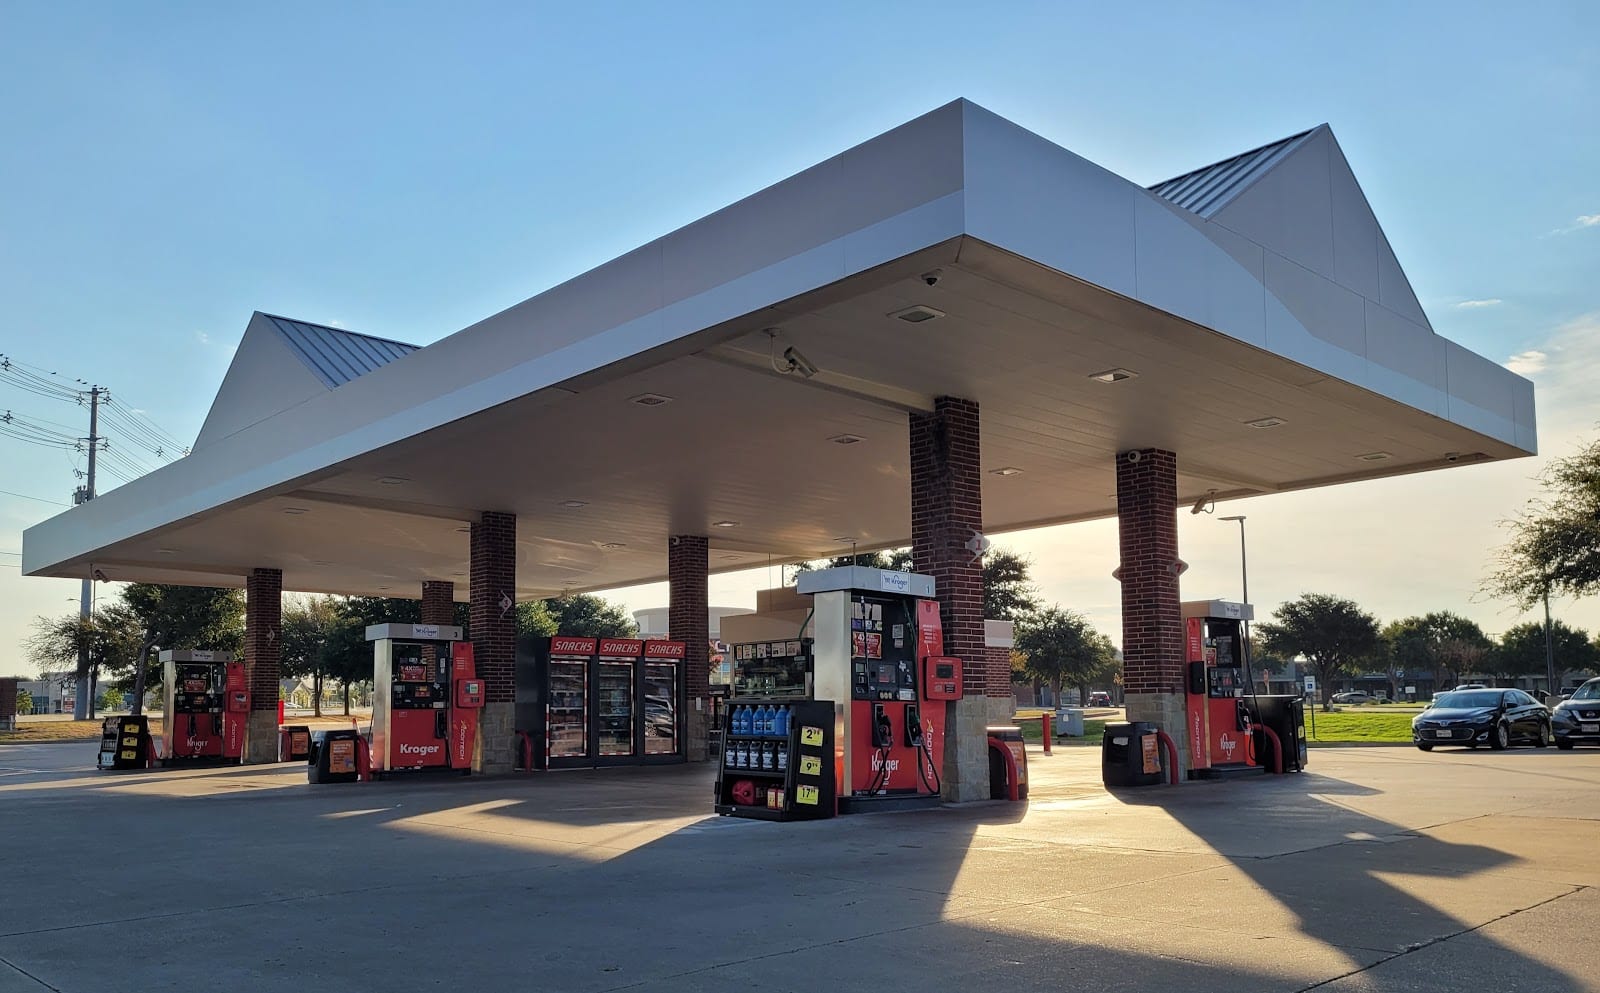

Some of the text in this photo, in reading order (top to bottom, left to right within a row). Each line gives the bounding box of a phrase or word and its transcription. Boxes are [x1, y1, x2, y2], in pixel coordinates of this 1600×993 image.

[976, 540, 982, 550] 1
[1174, 563, 1183, 573] 7
[554, 641, 593, 652] SNACKS
[602, 642, 640, 653] SNACKS
[648, 644, 682, 655] SNACKS
[400, 743, 440, 756] Kroger
